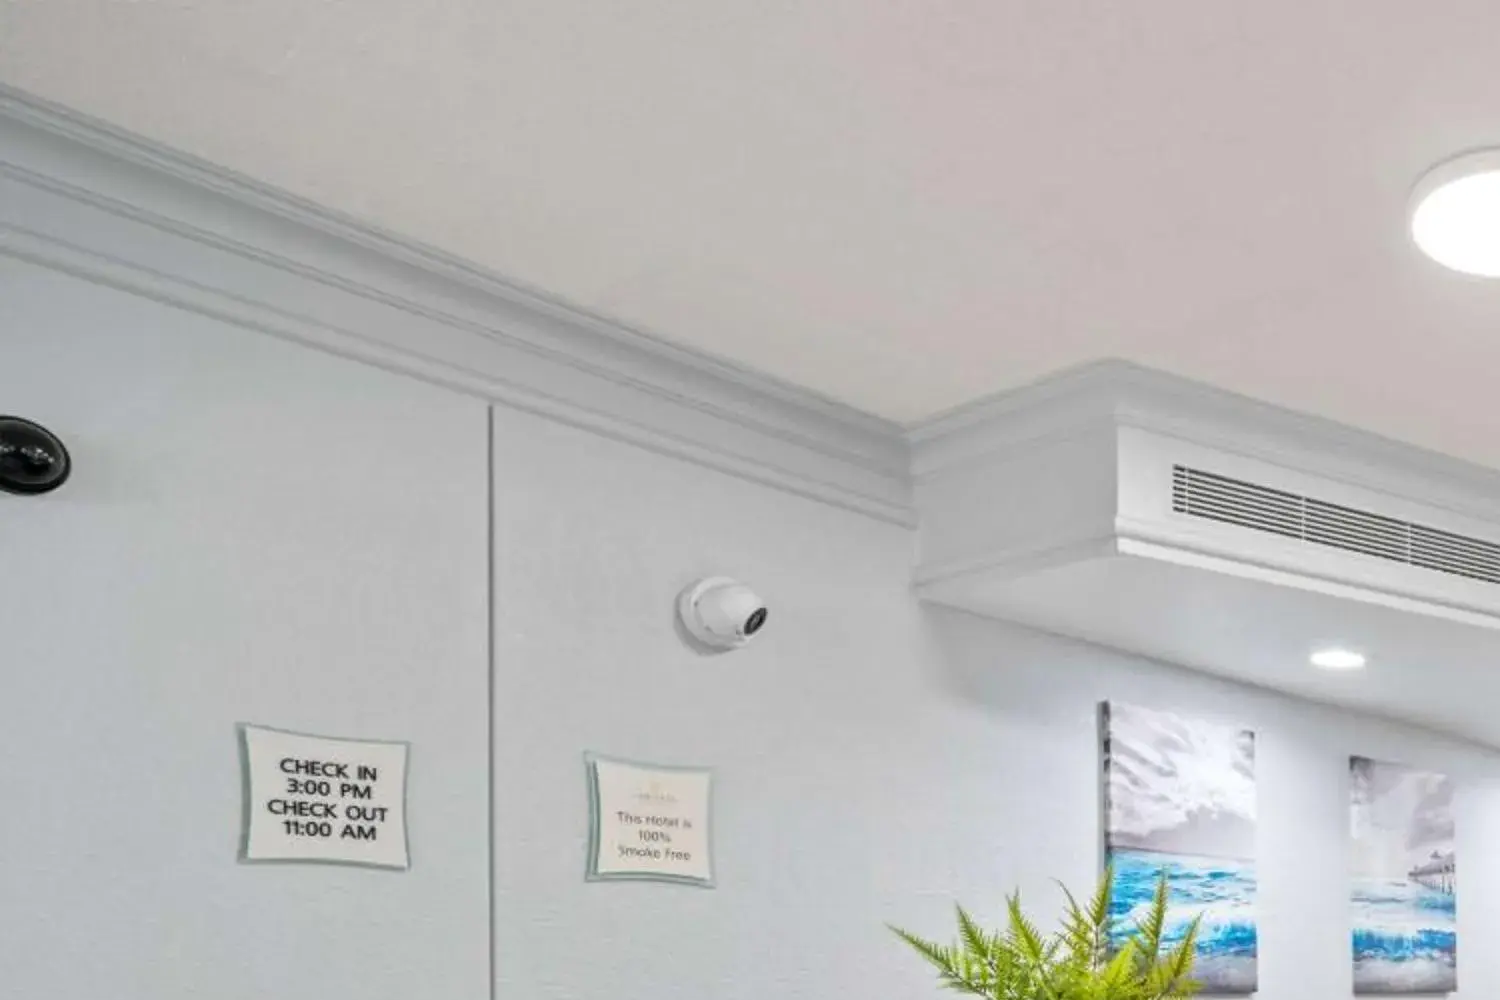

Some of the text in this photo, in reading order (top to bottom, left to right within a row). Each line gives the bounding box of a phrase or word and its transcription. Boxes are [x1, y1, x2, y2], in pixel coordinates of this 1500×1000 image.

[279, 758, 377, 781] CHECK IN
[287, 778, 372, 800] 3:00 PM
[267, 799, 389, 822] CHECK OUT
[282, 820, 377, 841] 11:00 AM
[638, 830, 672, 842] 100%
